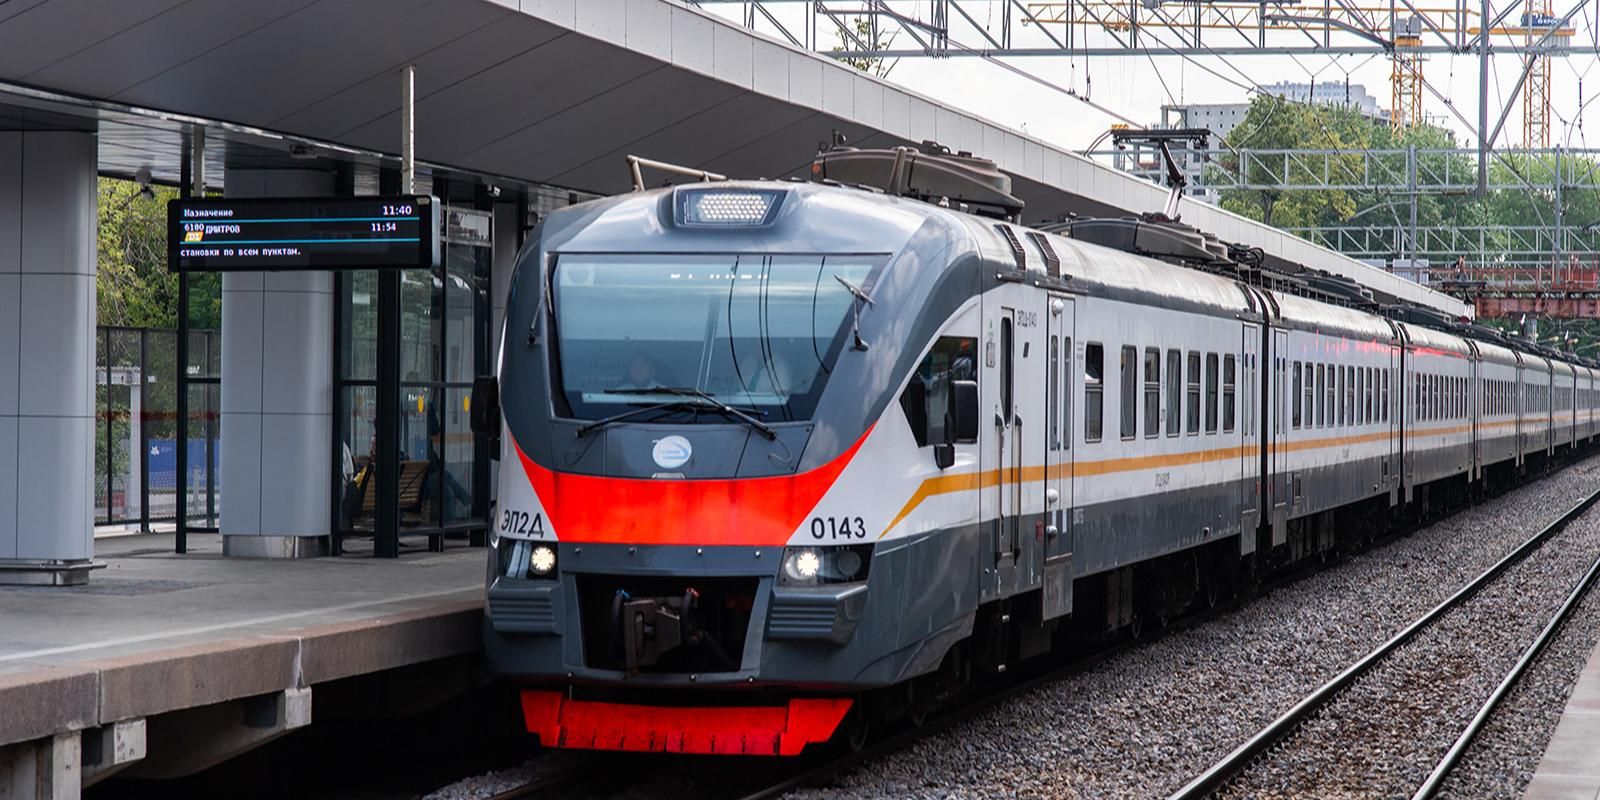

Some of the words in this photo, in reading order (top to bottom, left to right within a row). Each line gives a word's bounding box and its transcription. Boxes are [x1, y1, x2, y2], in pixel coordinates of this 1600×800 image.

[184, 208, 234, 217] Назначение
[383, 205, 412, 216] 11:40
[184, 223, 204, 232] 6180
[205, 224, 241, 235] ДМИТРОВ
[371, 222, 397, 232] 11:54
[180, 248, 220, 257] становки
[223, 248, 235, 256] по
[238, 248, 259, 256] всем
[262, 247, 301, 256] пунктам.
[501, 509, 545, 539] ЭП2Д
[811, 516, 866, 540] 0143
